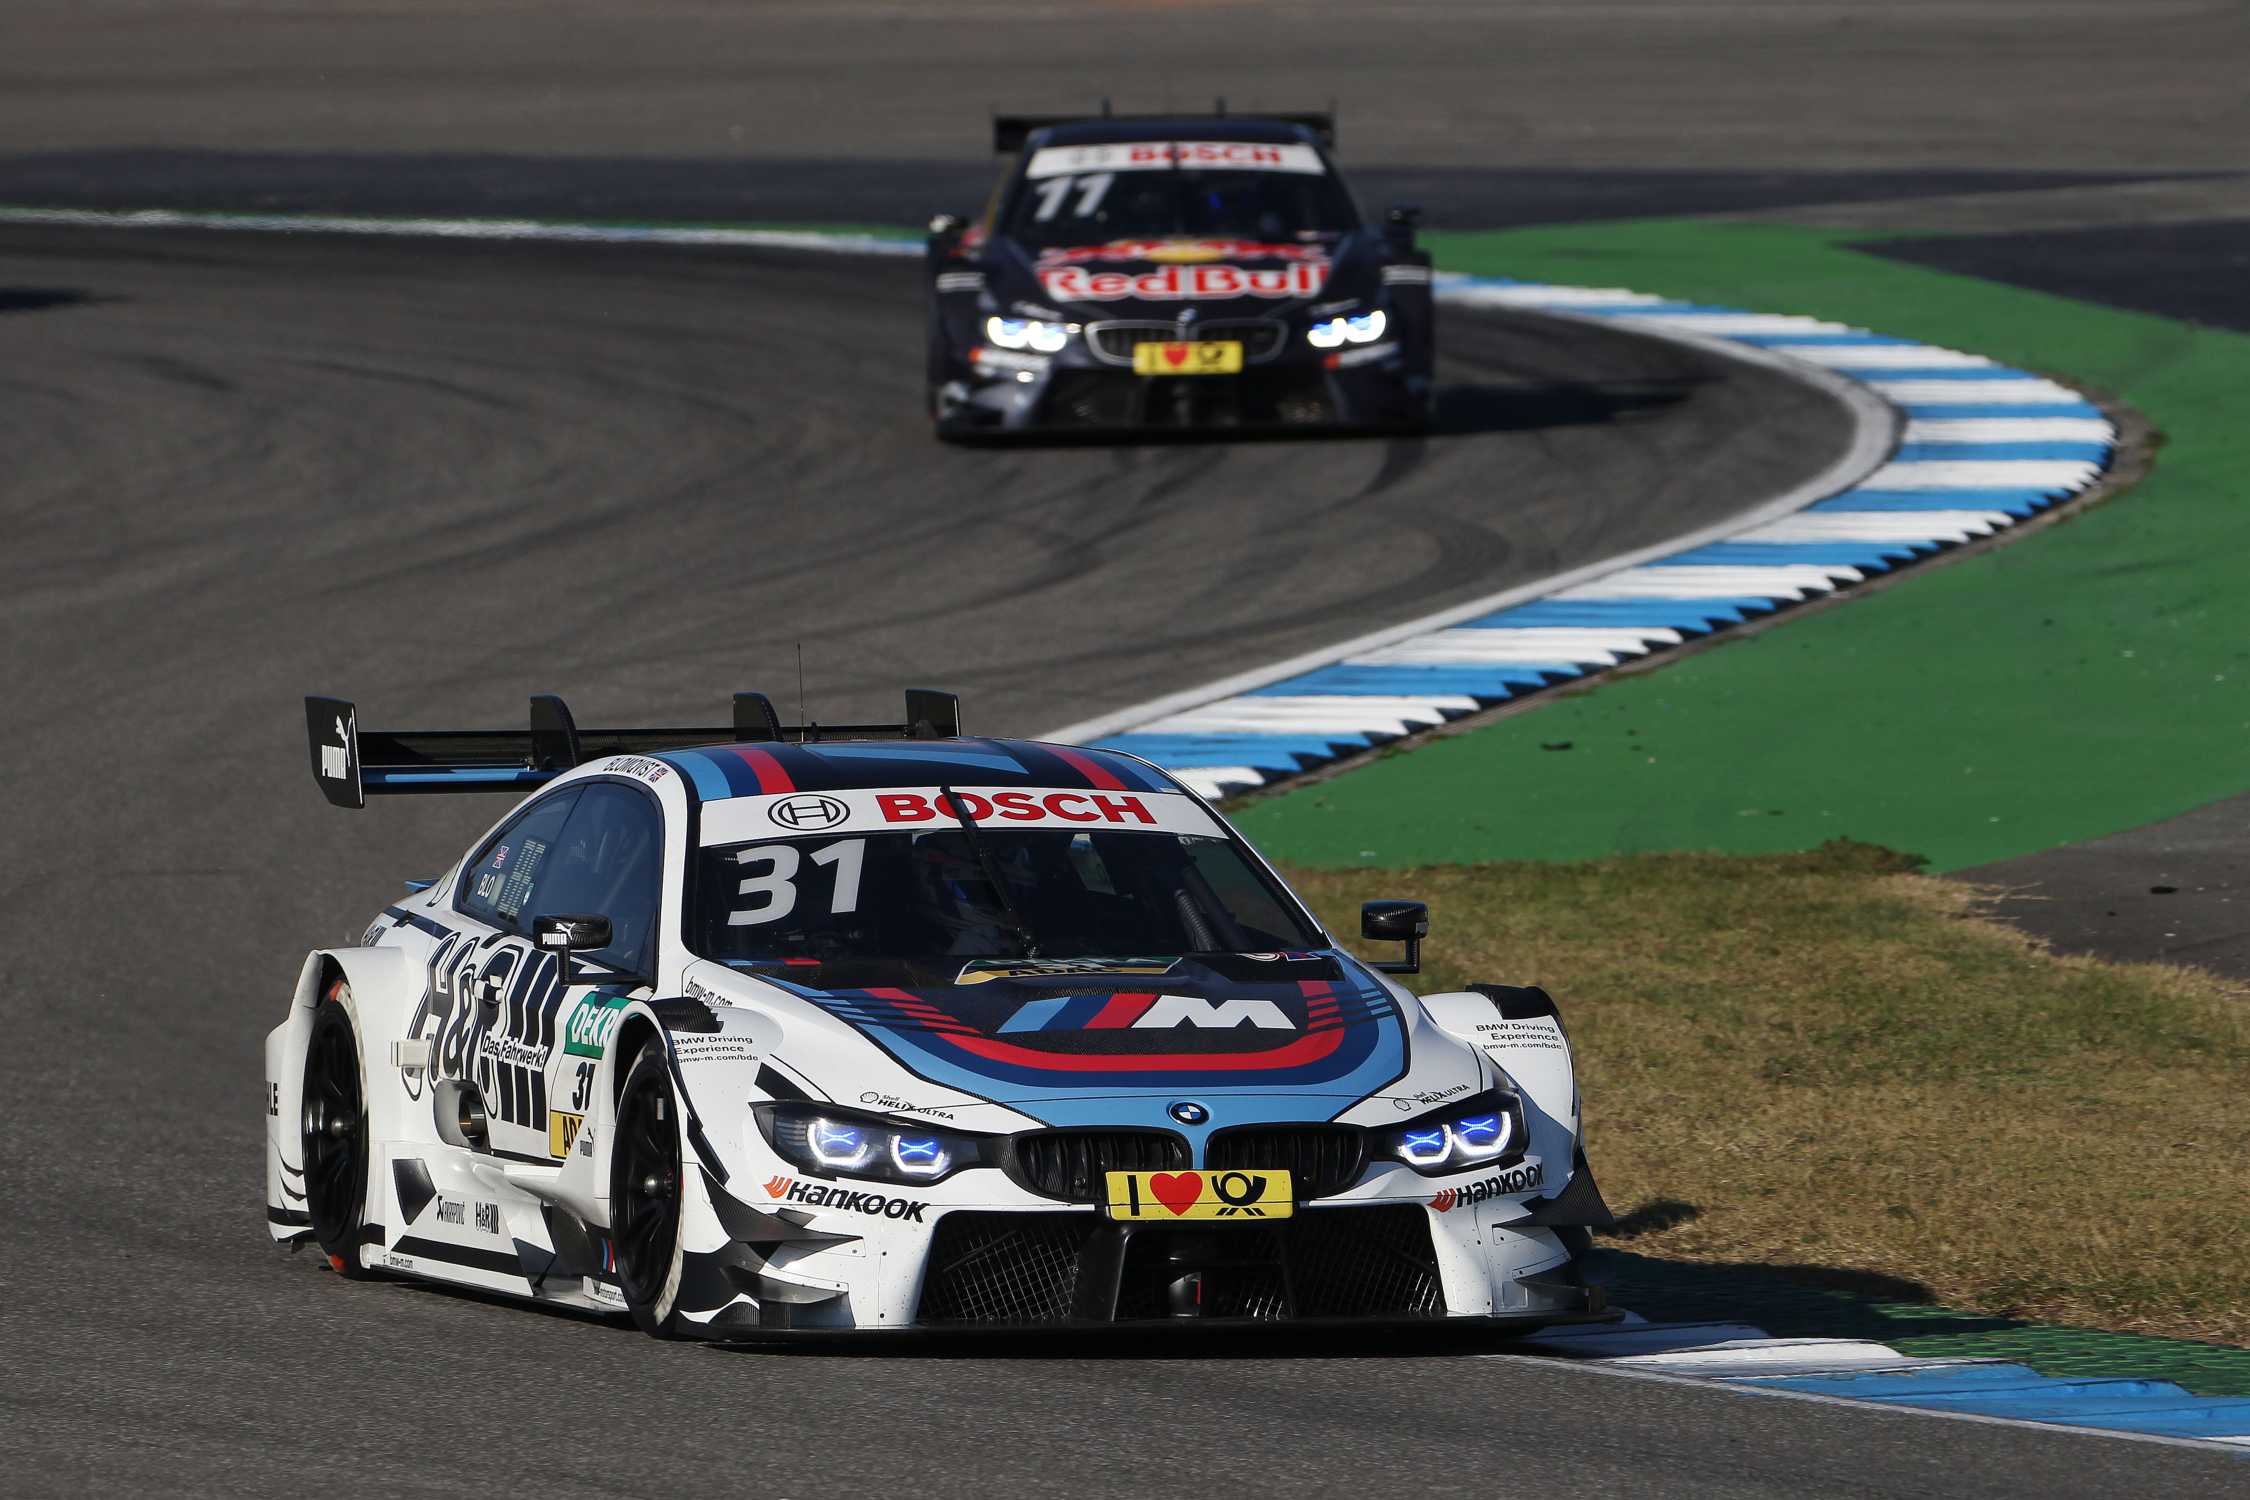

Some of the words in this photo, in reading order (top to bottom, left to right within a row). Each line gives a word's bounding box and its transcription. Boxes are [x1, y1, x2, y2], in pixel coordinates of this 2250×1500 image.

[1130, 145, 1281, 163] BOSCH
[1035, 173, 1115, 223] 11
[1038, 264, 1180, 300] Red
[875, 792, 1157, 824] BOSCH
[727, 838, 866, 926] 31
[542, 932, 568, 945] PUMA
[571, 1003, 621, 1047] DEKR
[1476, 1023, 1509, 1032] BMW
[1511, 1023, 1555, 1033] Driving
[1491, 1032, 1559, 1041] Experience
[482, 1035, 500, 1057] Das
[500, 1039, 547, 1068] Fahrwerk!
[672, 1036, 705, 1046] BMW
[708, 1034, 753, 1044] Driving
[675, 1045, 744, 1055] Experience
[572, 1061, 597, 1111] 31
[878, 1099, 917, 1111] HELIX
